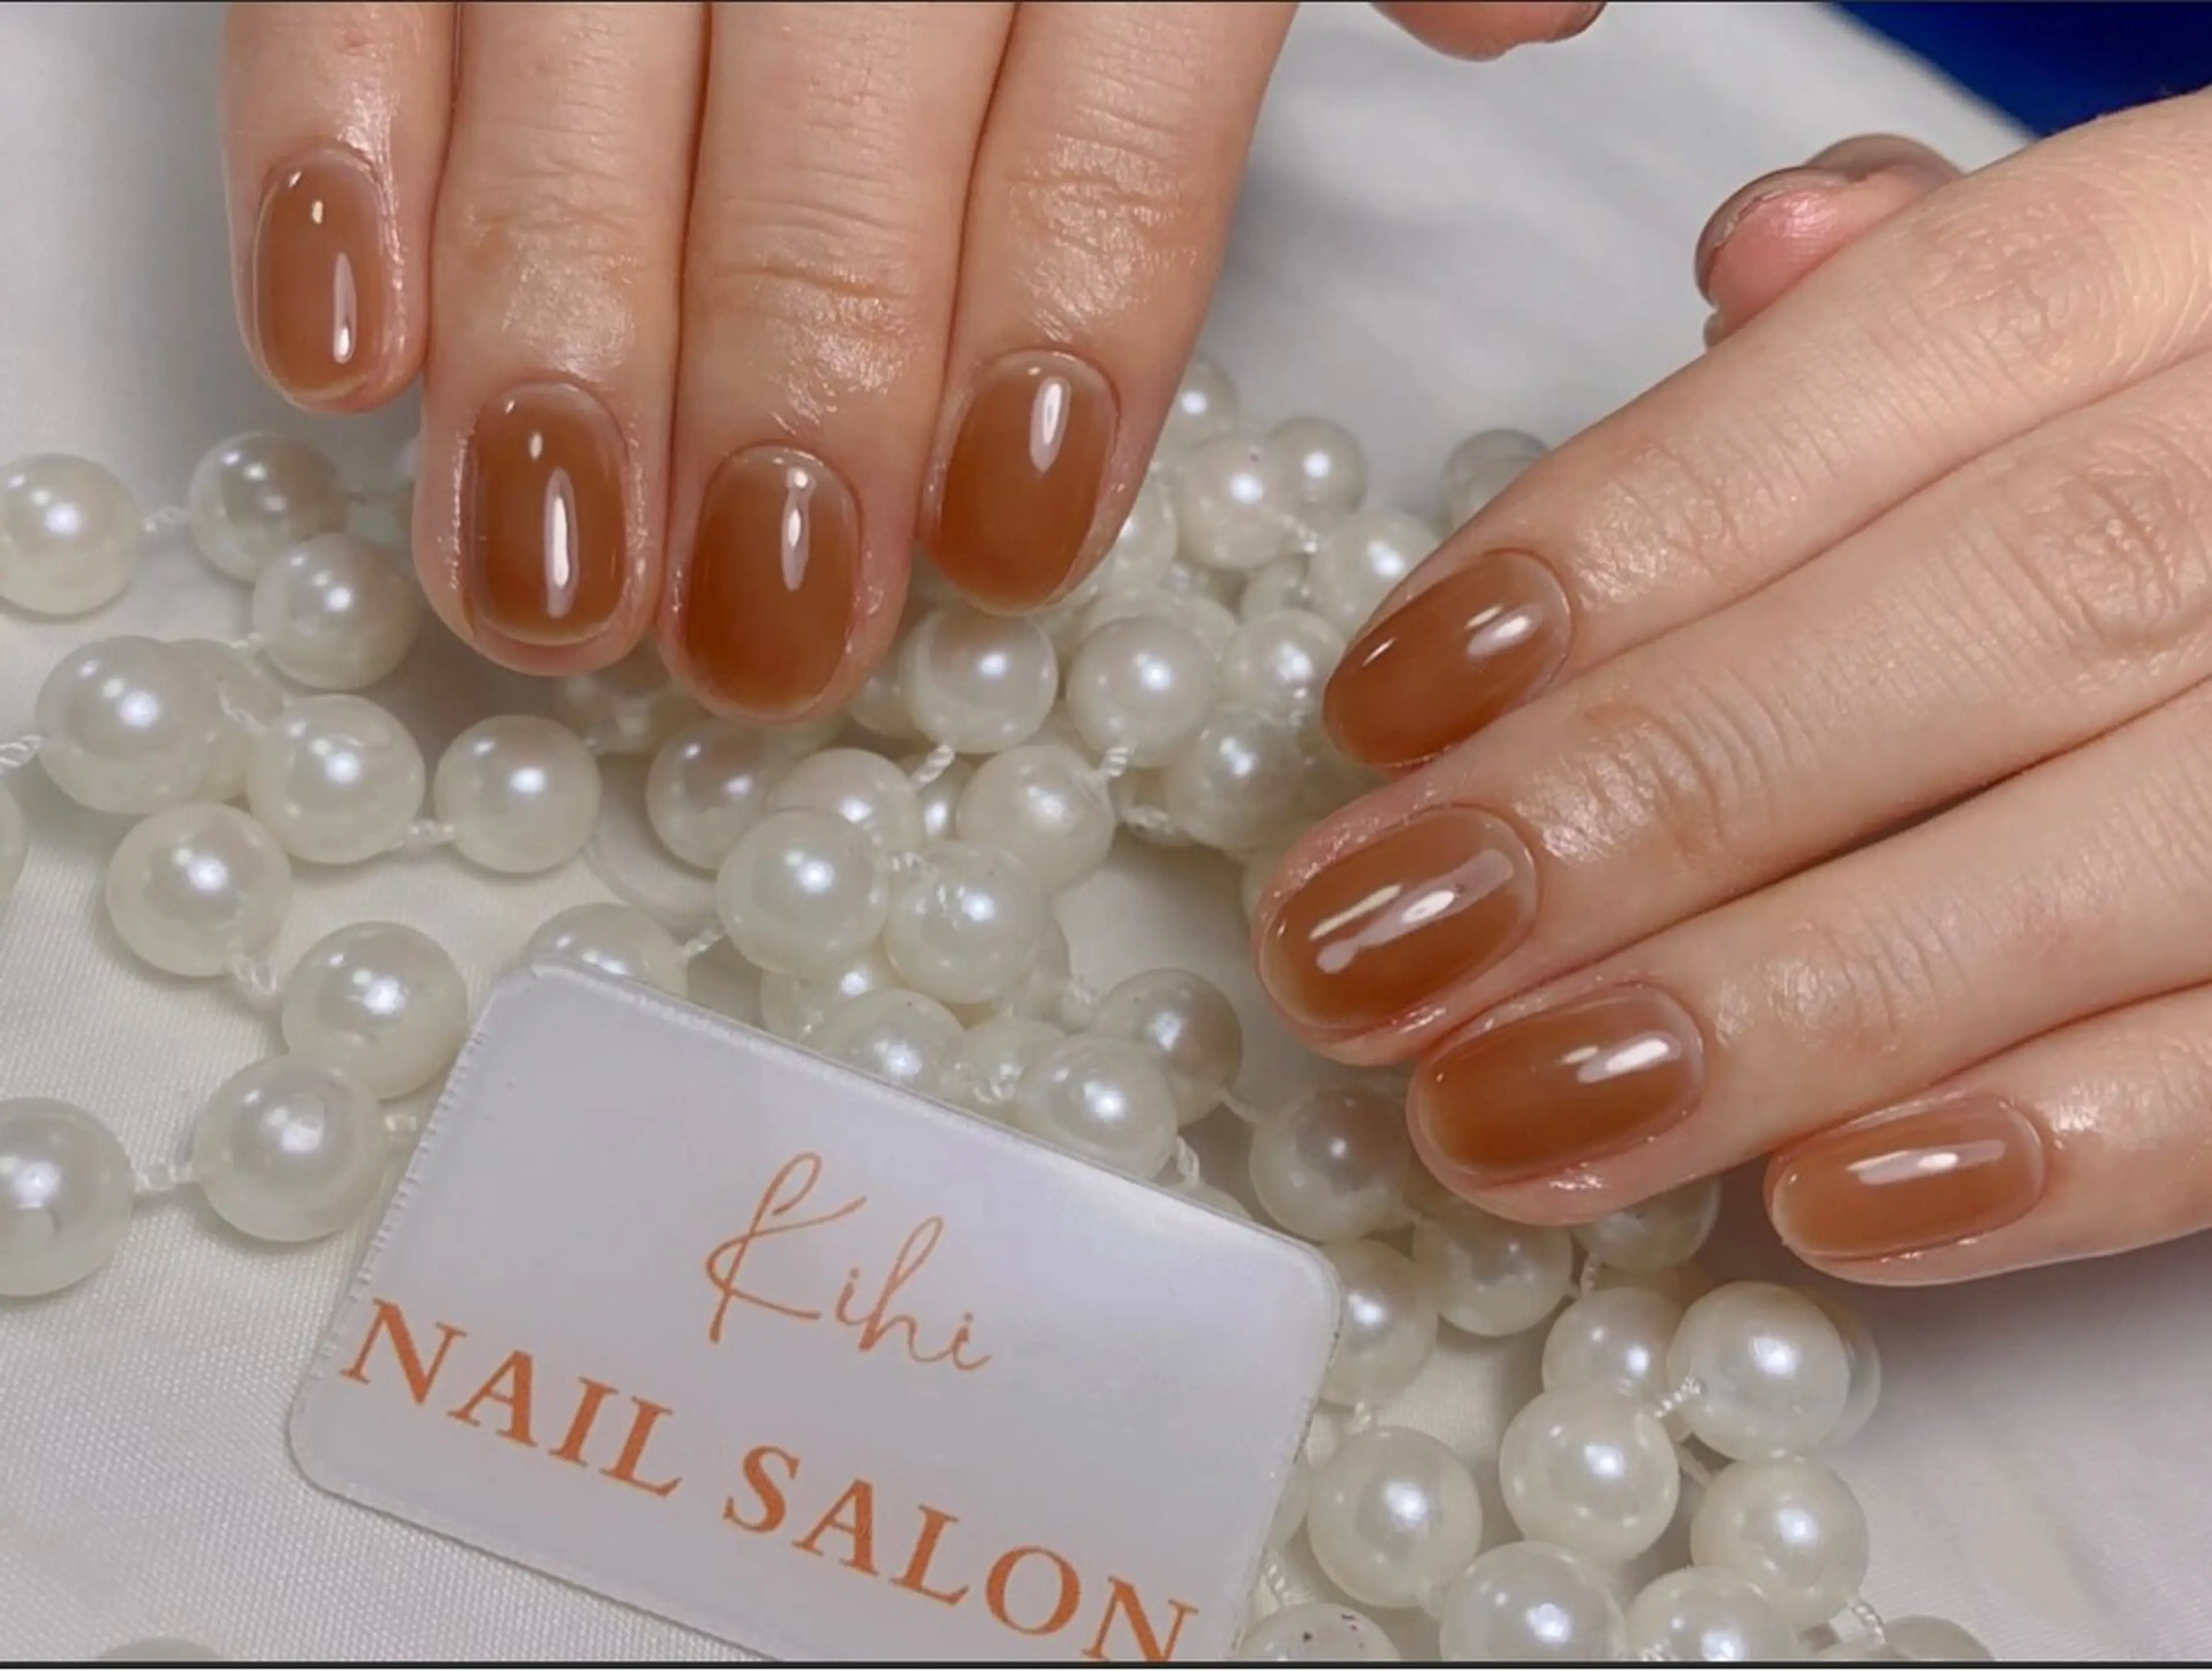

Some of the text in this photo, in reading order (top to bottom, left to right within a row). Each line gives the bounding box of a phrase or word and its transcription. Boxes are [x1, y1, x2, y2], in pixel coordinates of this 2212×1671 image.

[704, 1152, 991, 1371] Kihi
[340, 1298, 1199, 1662] NAIL SALON
